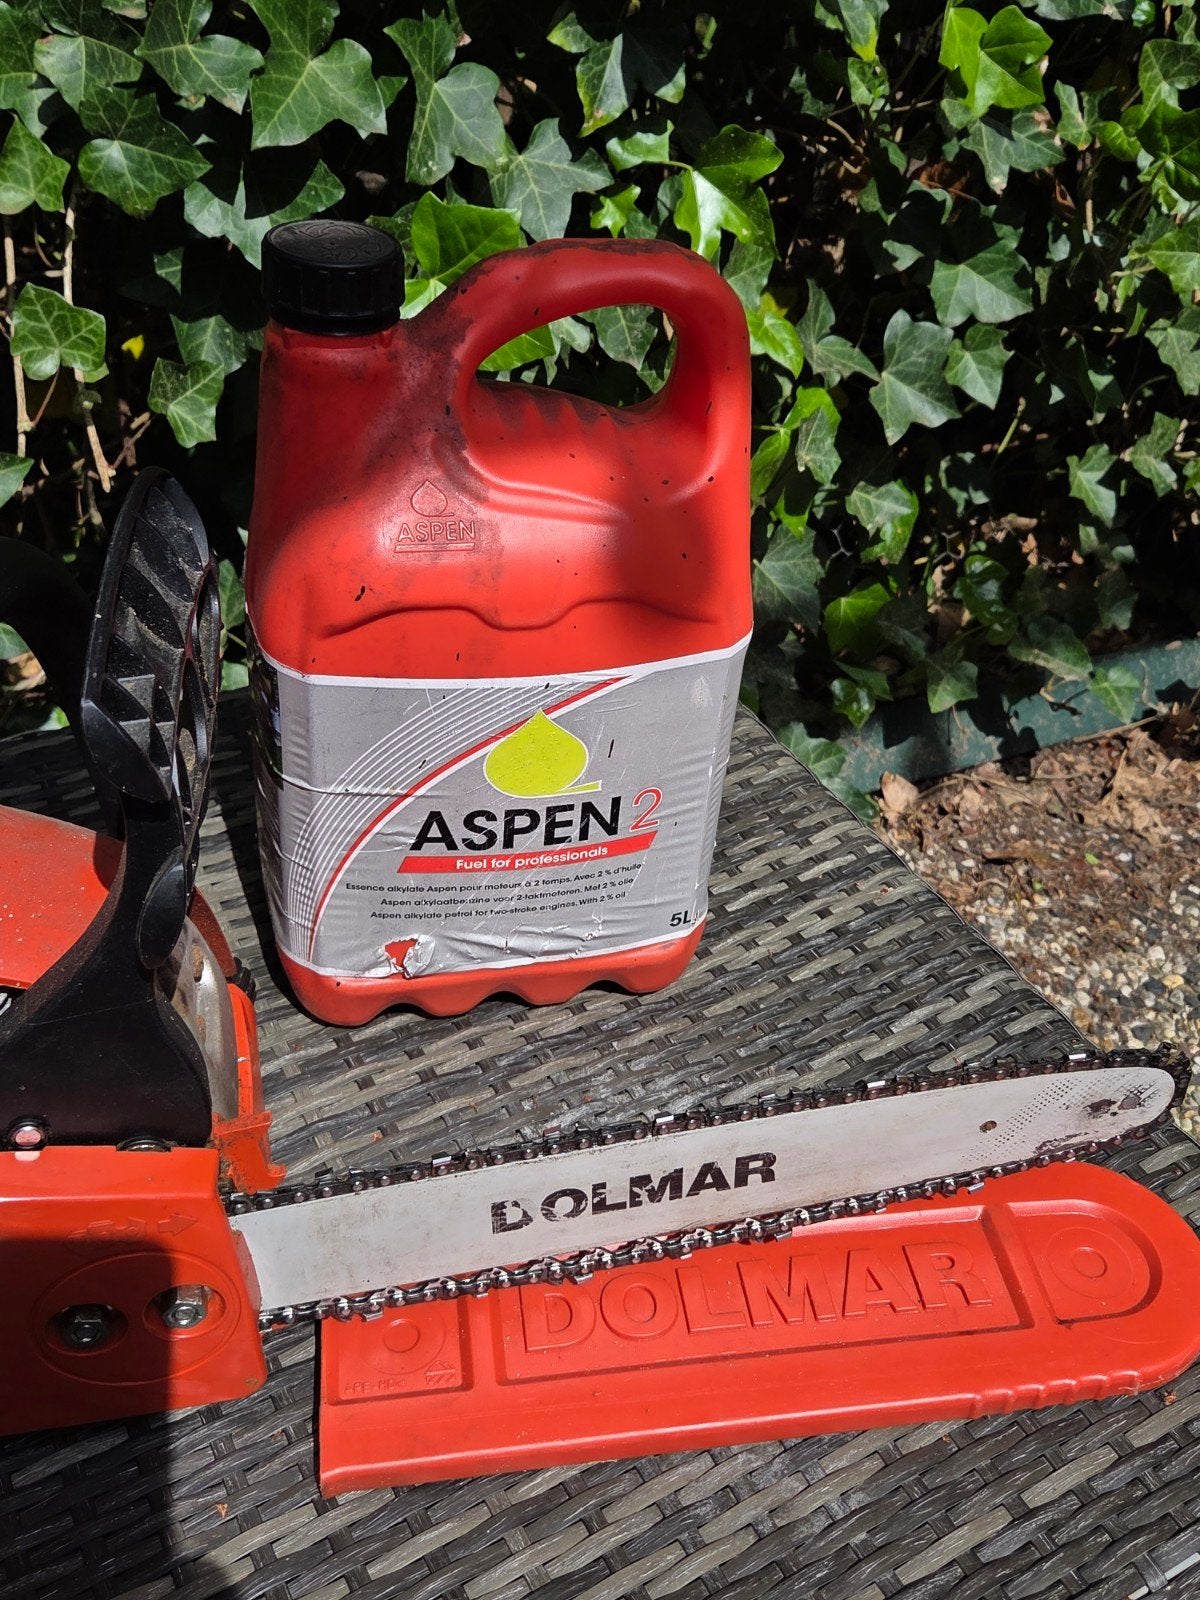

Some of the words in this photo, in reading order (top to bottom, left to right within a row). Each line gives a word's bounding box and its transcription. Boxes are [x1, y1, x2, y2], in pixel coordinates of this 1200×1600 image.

[397, 520, 476, 542] ASPEN
[409, 796, 622, 851] ASPEN
[629, 787, 663, 832] 2
[456, 859, 487, 869] Fuel
[491, 857, 512, 869] for
[515, 846, 608, 870] professionals
[345, 882, 385, 892] Essence
[387, 884, 425, 893] alkylate
[426, 885, 457, 893] Aspen
[460, 884, 482, 892] pour
[484, 882, 521, 890] moteurs
[525, 879, 532, 887] à
[542, 876, 572, 886] temps.
[574, 873, 596, 881] Avec
[613, 863, 642, 874] d'huile
[381, 898, 412, 907] Aspen
[414, 896, 491, 907] alkylaatbenzine
[516, 888, 583, 901] 2-taktmotoren.
[584, 884, 601, 893] Met
[618, 877, 634, 886] olie
[370, 911, 402, 920] Aspen
[404, 911, 442, 921] alkylate
[444, 910, 473, 919] petrol
[475, 909, 488, 917] for
[490, 905, 537, 916] two-stroke
[539, 900, 578, 911] engines.
[579, 896, 598, 905] With
[615, 891, 626, 899] oil
[669, 910, 693, 927] 5L
[490, 1151, 777, 1235] DOLMAR
[519, 1239, 993, 1353] DOLMAR
